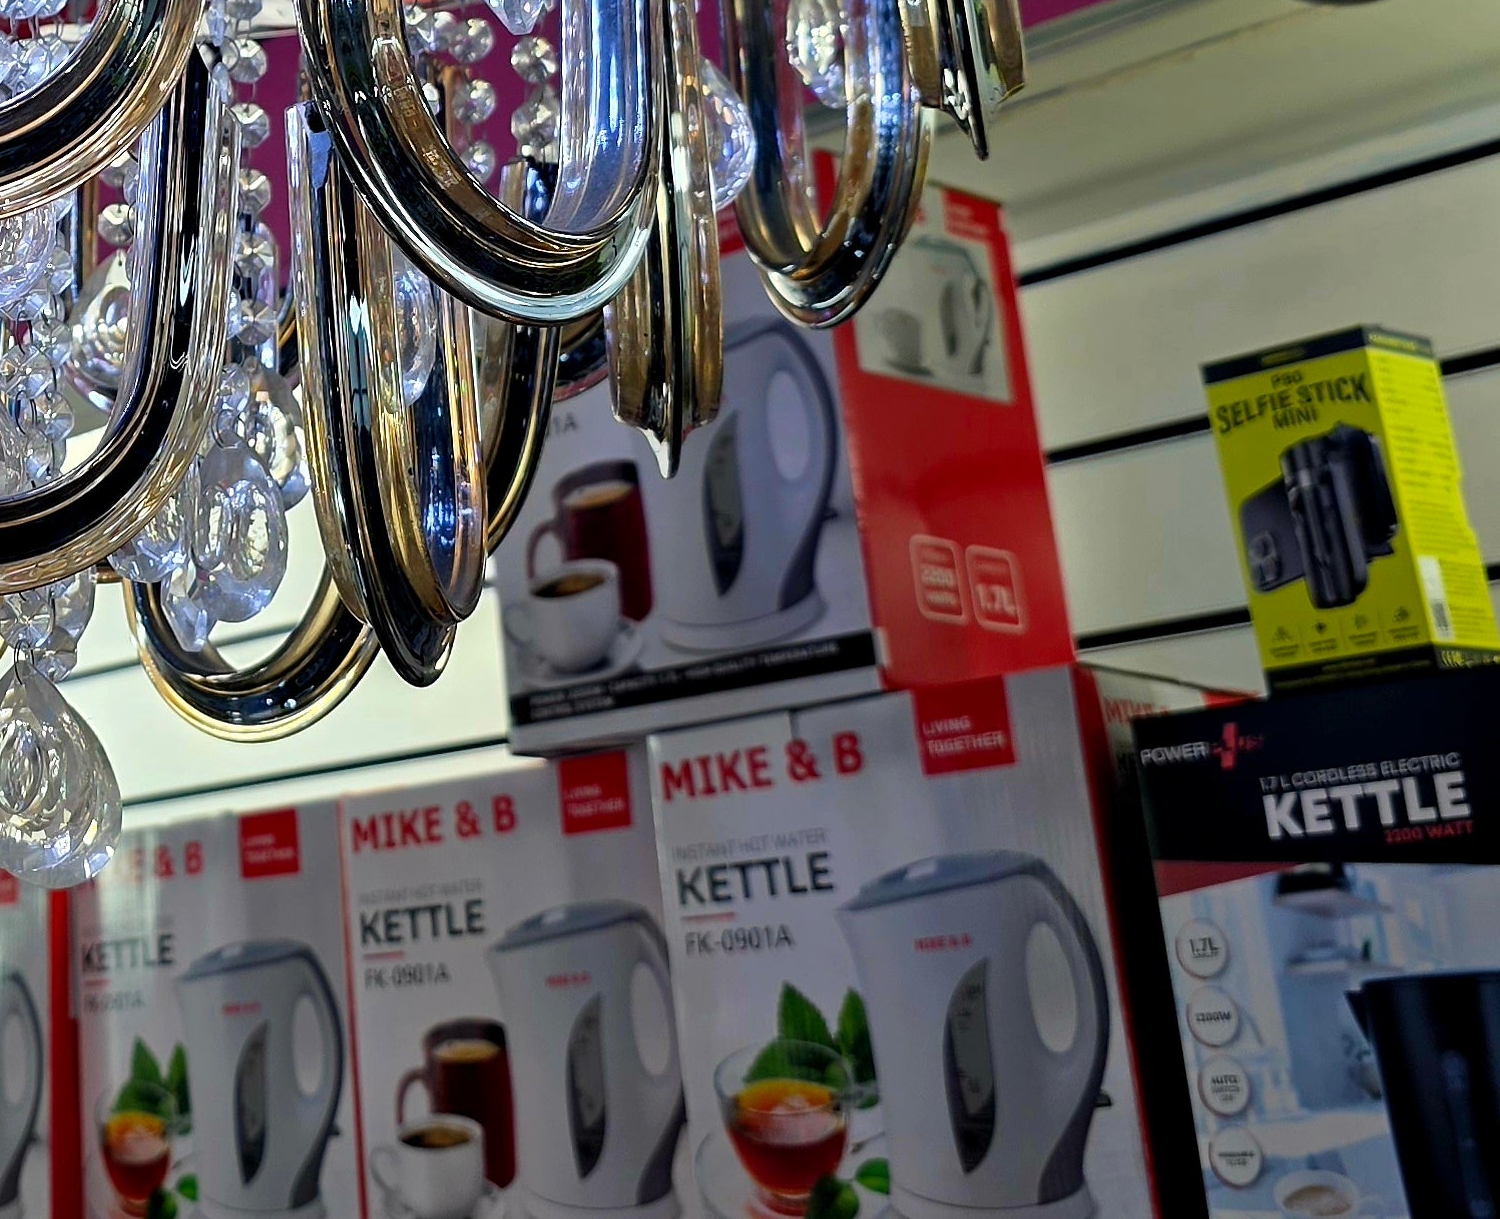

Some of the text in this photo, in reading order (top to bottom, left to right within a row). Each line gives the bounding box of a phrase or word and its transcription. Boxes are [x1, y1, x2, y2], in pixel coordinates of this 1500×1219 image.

[1216, 373, 1371, 435] SELFIE STICK
[1272, 405, 1318, 430] MINI
[922, 715, 972, 736] LIVING
[926, 730, 1006, 757] TOGETHER
[660, 730, 865, 801] MIKE & B
[1140, 741, 1209, 767] POWER
[1380, 751, 1462, 776] ELECTRIC
[352, 793, 518, 853] MIKE & B
[1262, 770, 1471, 841] KETTLE
[1426, 819, 1475, 839] WATT
[675, 851, 835, 906] KETTLE
[360, 898, 486, 946] KETTLE
[685, 923, 793, 957] FK-0901A
[82, 934, 173, 974] KETTLE
